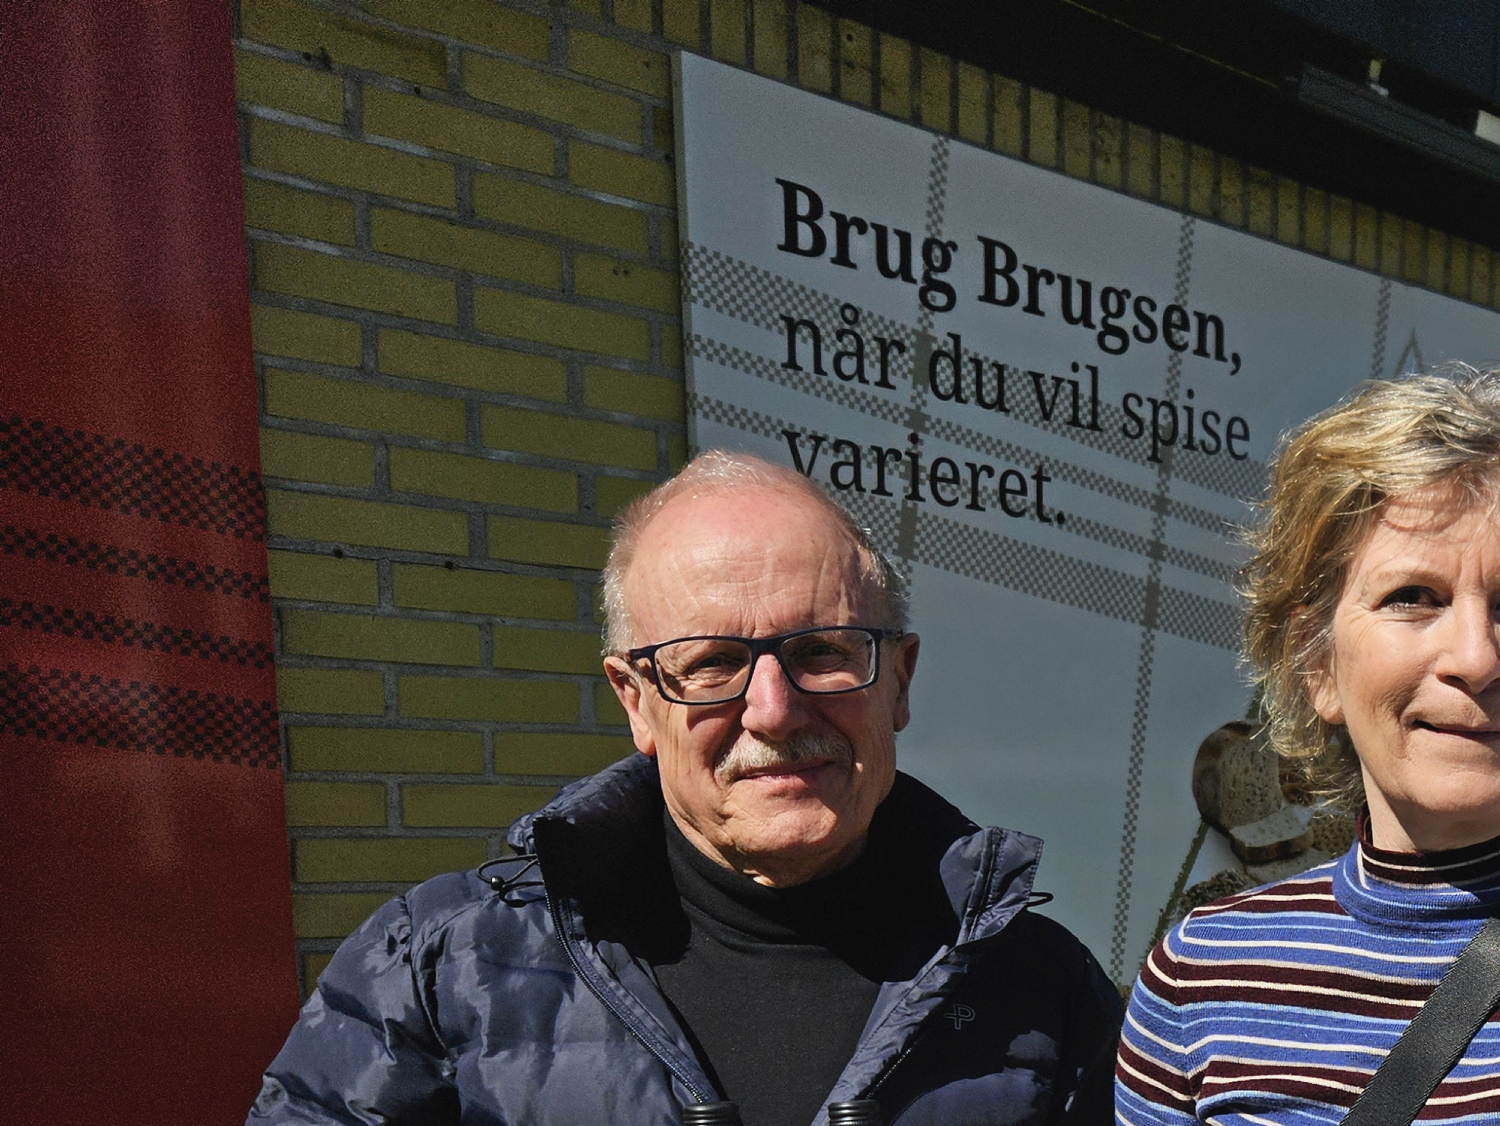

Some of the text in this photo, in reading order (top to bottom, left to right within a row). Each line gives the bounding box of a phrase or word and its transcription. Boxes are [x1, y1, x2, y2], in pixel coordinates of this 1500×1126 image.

[776, 178, 1244, 376] Brug Brugsen,
[780, 303, 1251, 462] når du vil spise
[782, 428, 1067, 526] varieret.
